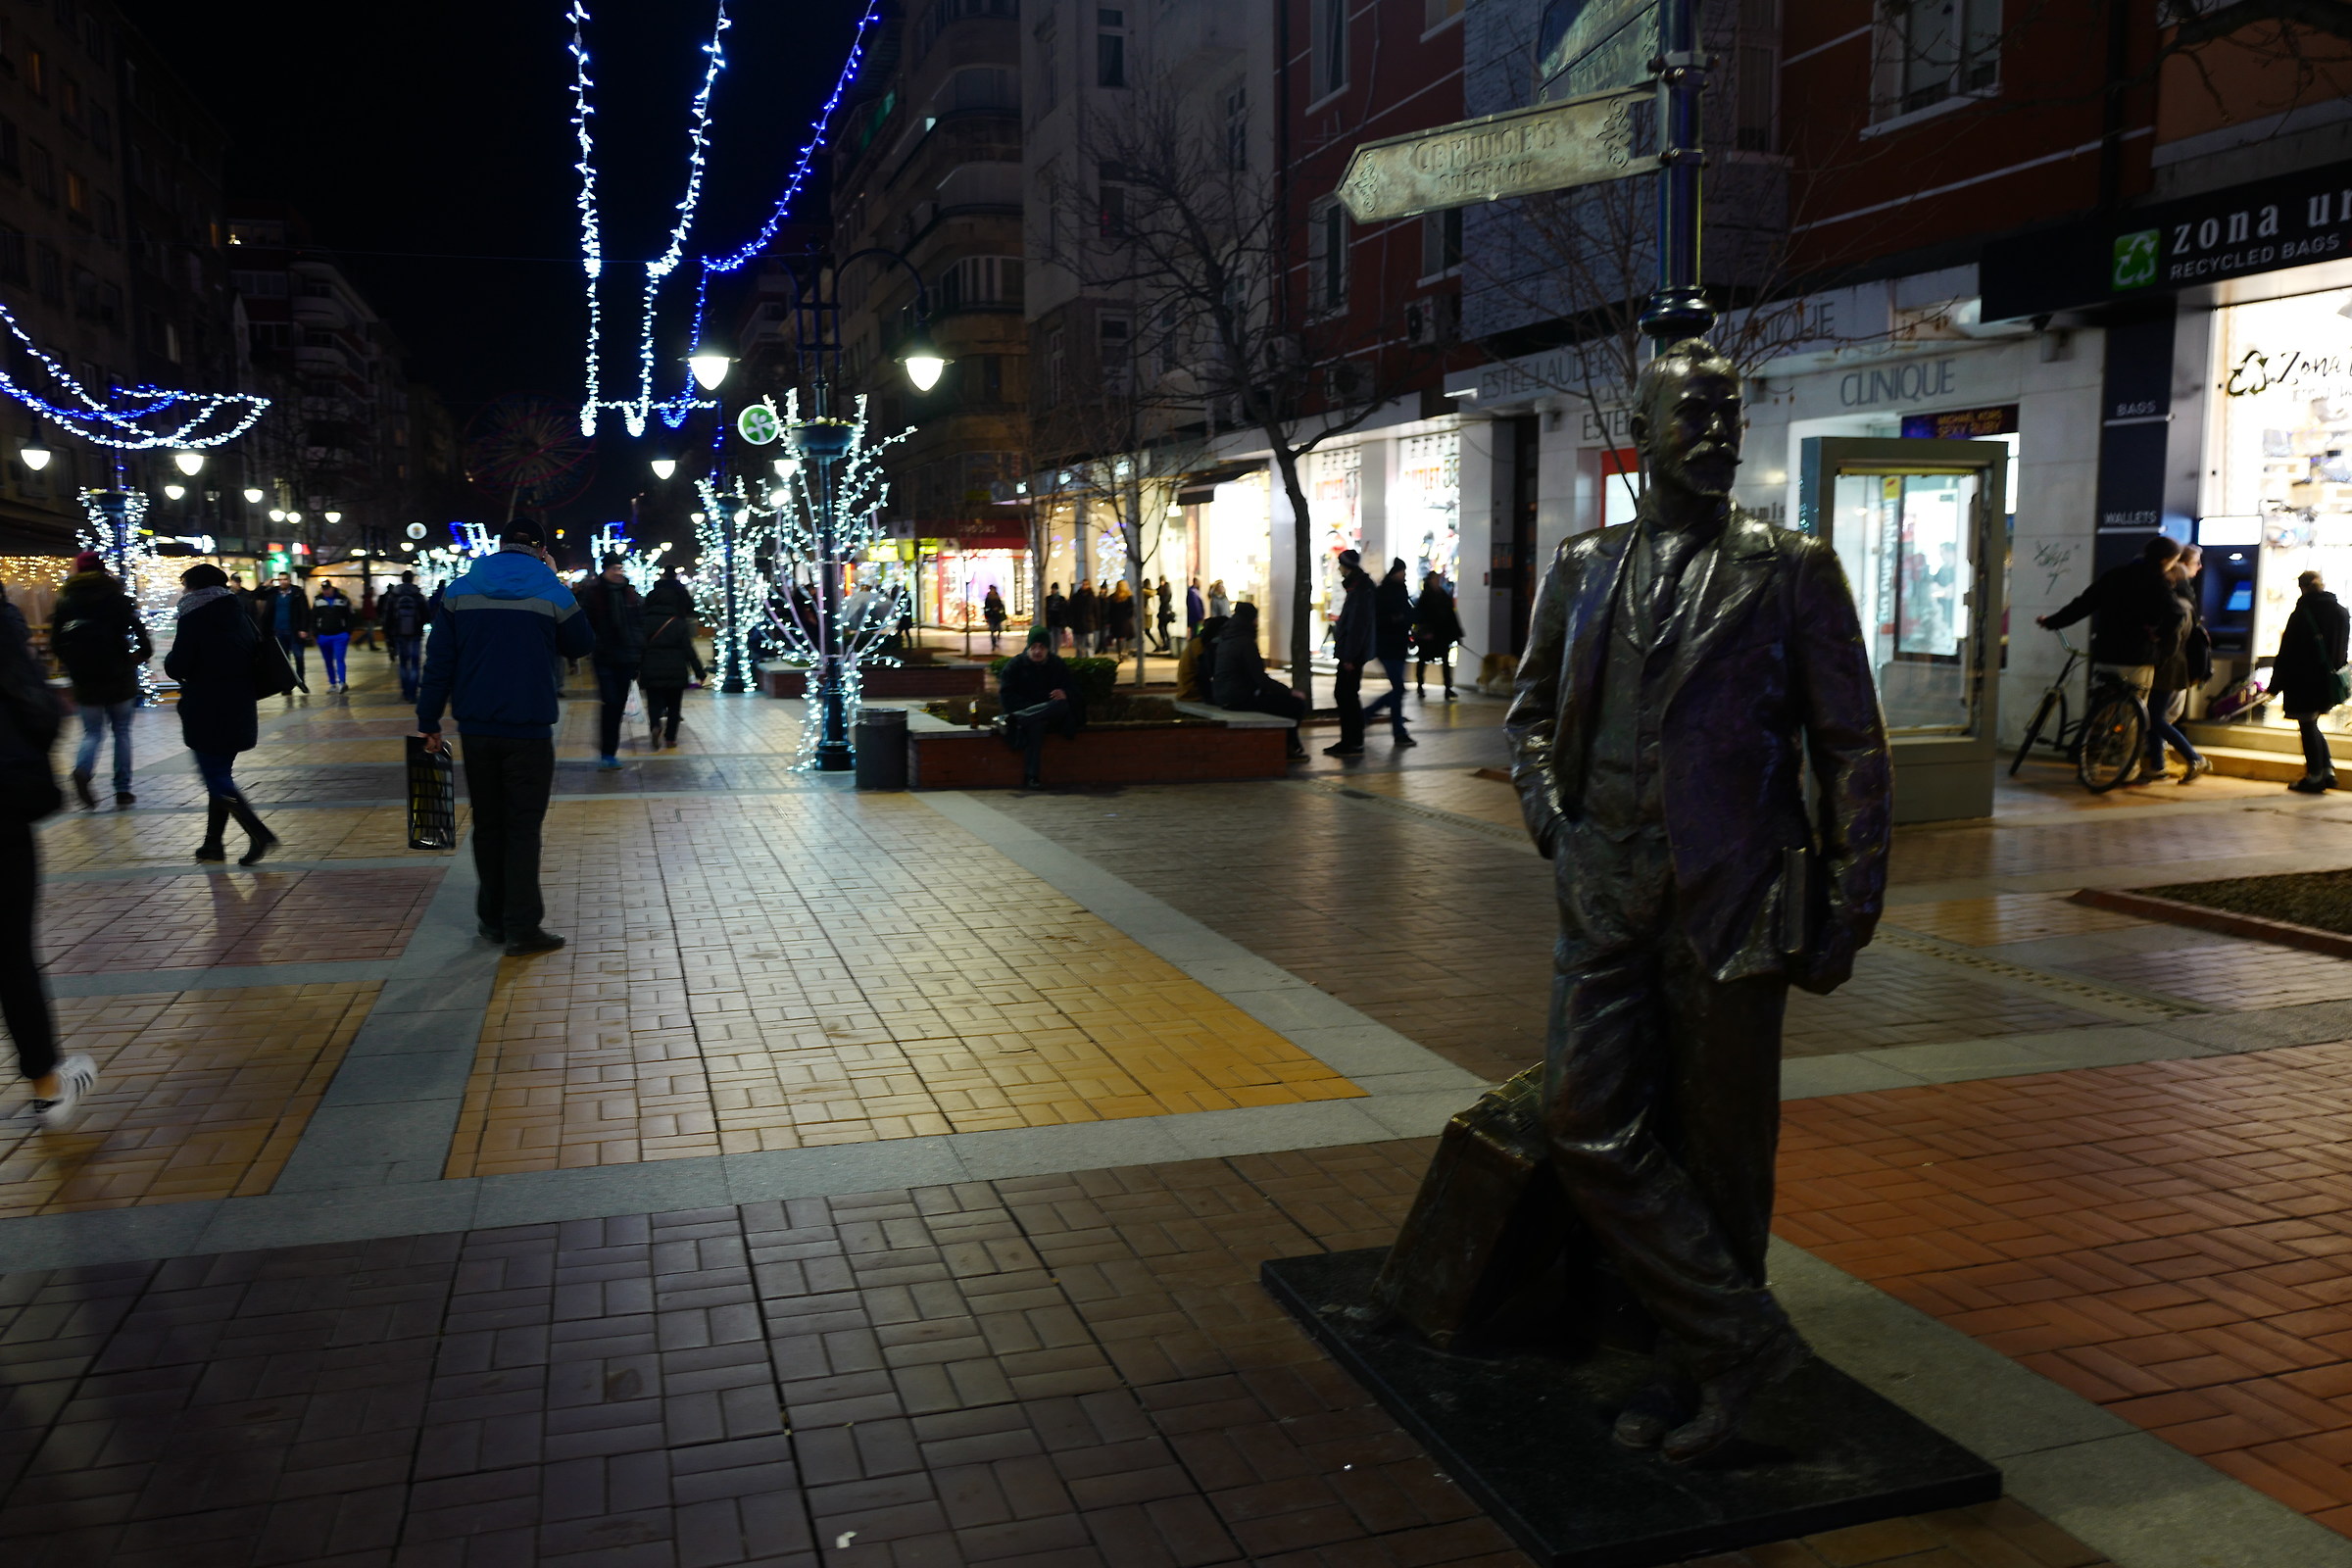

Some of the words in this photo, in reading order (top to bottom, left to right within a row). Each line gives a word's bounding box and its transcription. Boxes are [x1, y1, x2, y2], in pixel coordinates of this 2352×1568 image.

[2172, 204, 2280, 256] zona
[2170, 245, 2274, 280] RECYCLED
[2280, 232, 2341, 260] BAGS
[1839, 358, 1956, 407] CLINIQUE
[2116, 400, 2157, 417] BAGS
[2103, 509, 2157, 525] WALLETS
